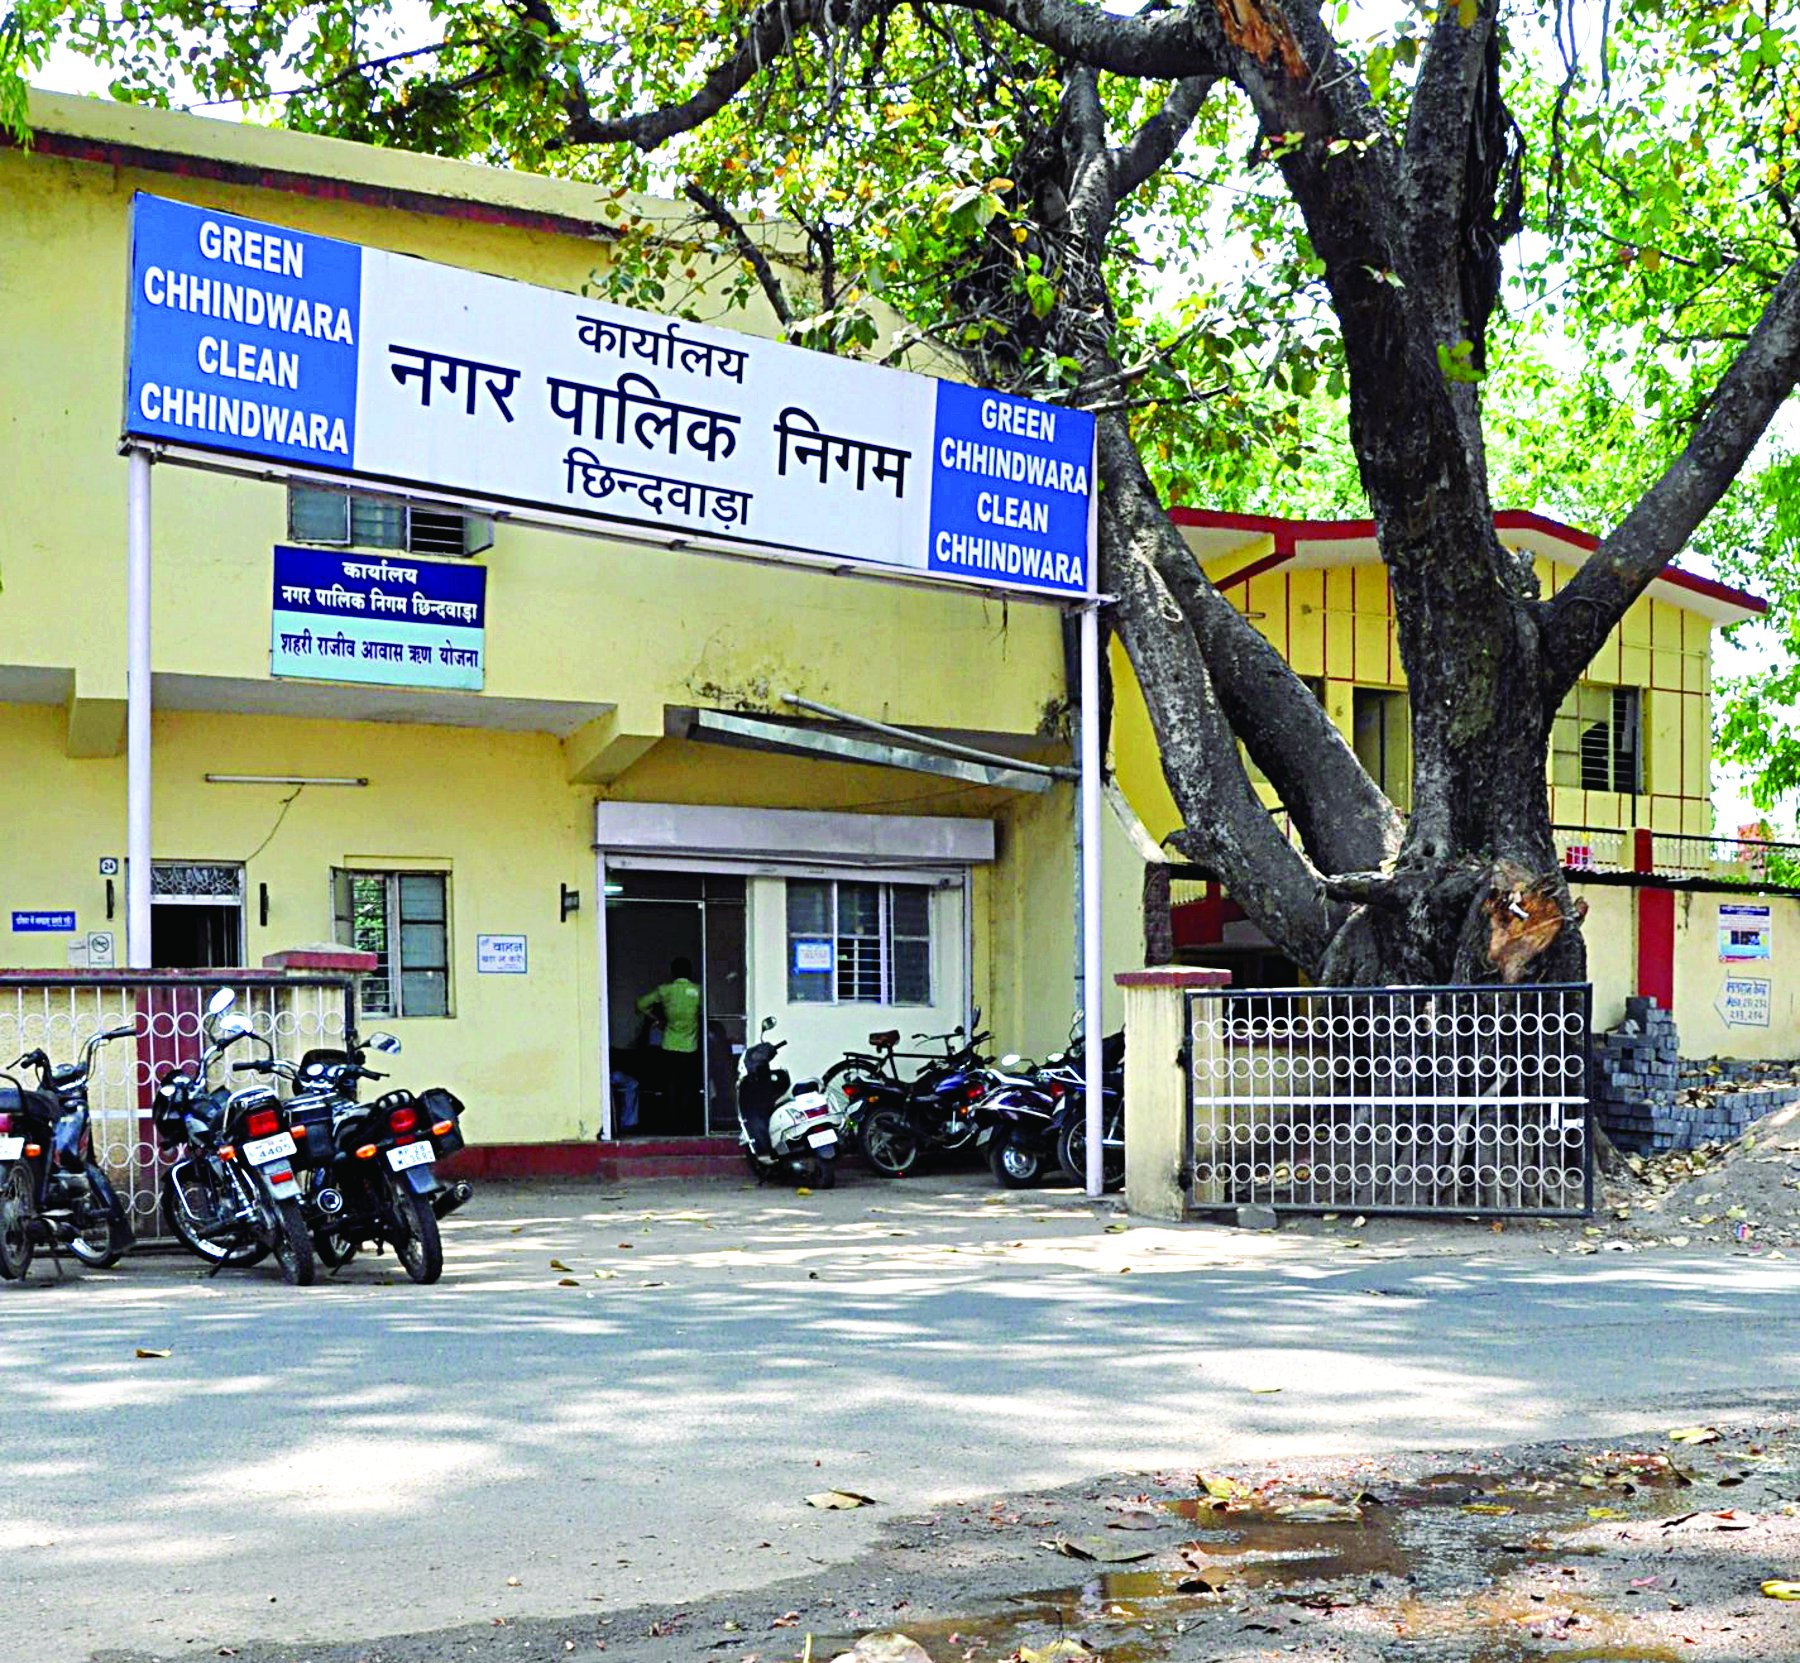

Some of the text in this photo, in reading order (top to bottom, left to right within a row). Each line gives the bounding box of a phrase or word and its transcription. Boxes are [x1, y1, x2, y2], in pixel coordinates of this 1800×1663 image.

[199, 220, 304, 279] GREEN
[143, 266, 354, 344] CHHINDWARA
[198, 335, 299, 390] CLEAN
[576, 315, 749, 384] कार्यालय
[140, 382, 349, 455] CHHINDWARA
[388, 344, 911, 498] नगर पालिक निगम
[981, 398, 1055, 442] GREEN
[563, 447, 753, 530] छिन्दवाड़ा
[940, 437, 1088, 496] CHHINDWARA
[977, 491, 1049, 534] CLEAN
[342, 559, 418, 584] कार्यालय
[936, 531, 1084, 586] CHHINDWARA
[281, 584, 477, 623] नगर पालिक निगम छिन्दवाड़ा
[281, 628, 478, 667] शहरी राजीव आवास ऋण योजना
[104, 861, 114, 870] 24
